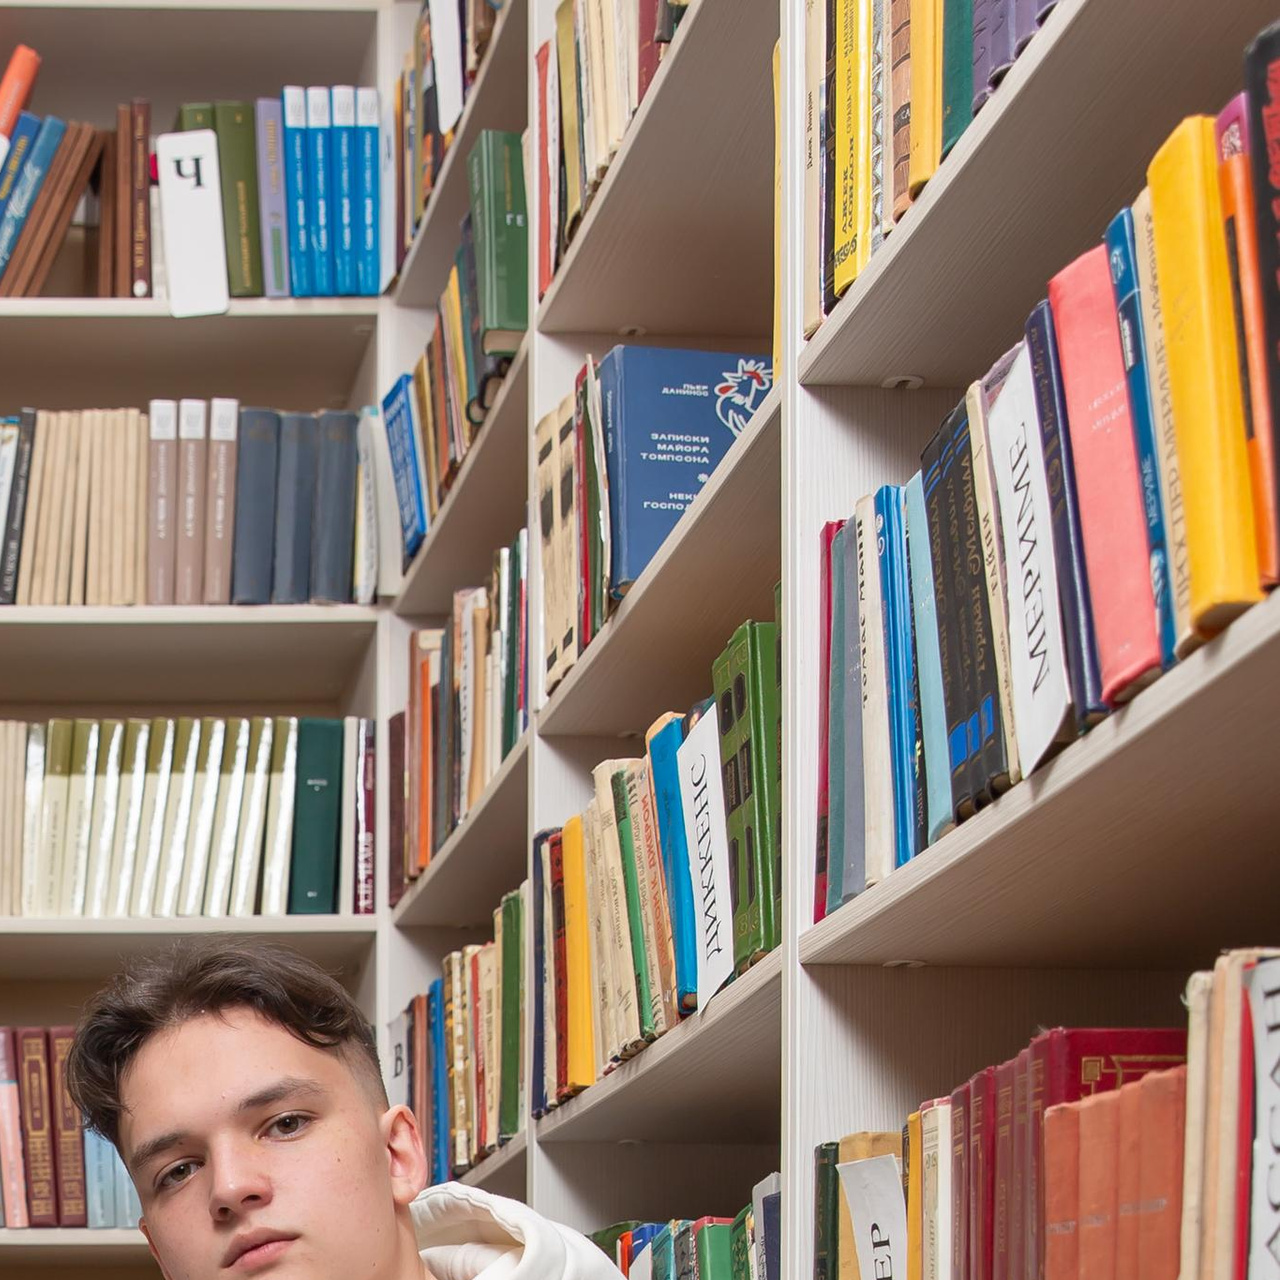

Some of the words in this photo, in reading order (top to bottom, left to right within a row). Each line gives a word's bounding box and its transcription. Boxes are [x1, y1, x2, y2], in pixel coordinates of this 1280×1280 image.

[173, 156, 205, 188] Ч
[651, 433, 710, 444] ЗАПИСКИ
[657, 443, 710, 454] МАЙОРА
[640, 453, 710, 464] ТОМПСОНА
[981, 512, 999, 594] ТАЙПИ
[1008, 422, 1051, 698] МЕРИМЕ
[641, 794, 656, 866] ДЖЕРОМ
[690, 753, 722, 964] ДИККЕНС
[393, 1043, 403, 1079] В
